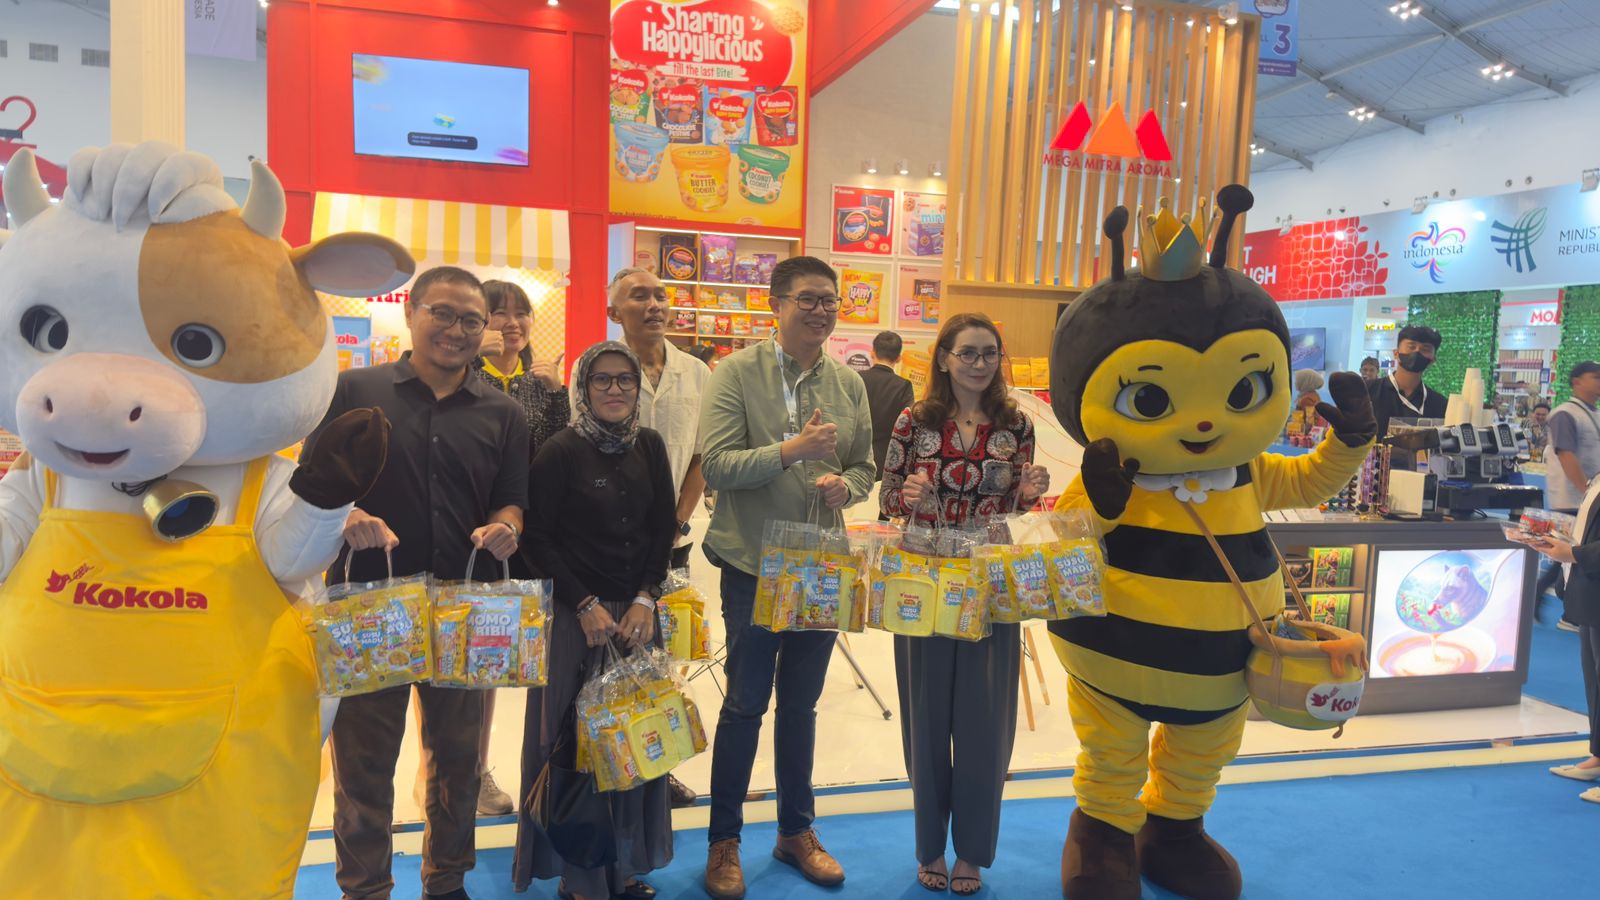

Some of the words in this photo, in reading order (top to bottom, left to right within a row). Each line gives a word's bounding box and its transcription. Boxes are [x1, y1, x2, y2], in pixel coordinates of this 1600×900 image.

[661, 4, 744, 41] Sharing
[642, 21, 764, 62] Happylicious
[1273, 24, 1291, 55] 3
[673, 63, 684, 74] till
[686, 64, 699, 75] the
[700, 65, 714, 76] last
[1043, 154, 1080, 168] MEGA
[1085, 158, 1122, 172] MITRA
[1127, 162, 1171, 177] AROMA
[1559, 226, 1600, 242] MINIS
[1014, 561, 1044, 573] SUSU
[1056, 556, 1085, 569] SUSU
[1062, 564, 1093, 577] MADU
[73, 582, 208, 609] Kokola
